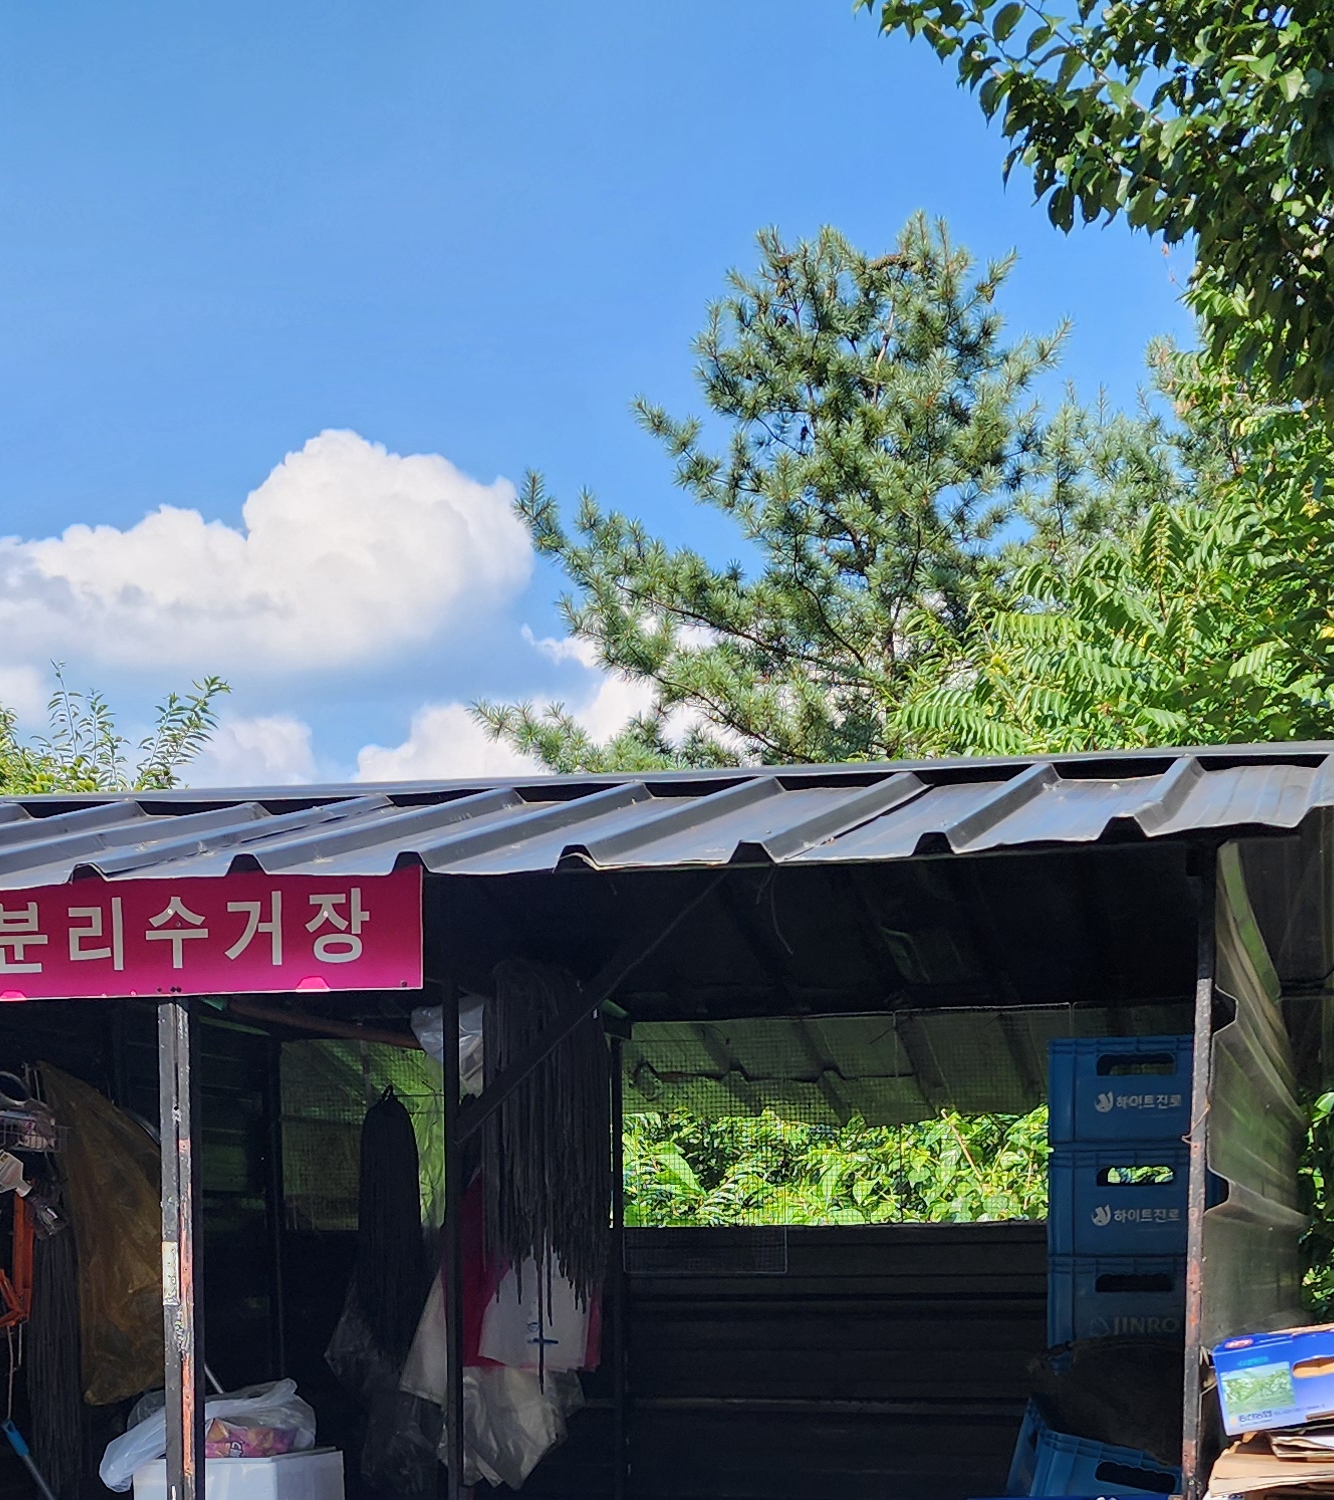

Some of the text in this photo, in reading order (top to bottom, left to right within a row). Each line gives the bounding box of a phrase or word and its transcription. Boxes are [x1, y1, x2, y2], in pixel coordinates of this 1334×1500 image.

[1116, 1093, 1182, 1109] 하이트진로
[1114, 1207, 1180, 1223] 하이트진로
[1114, 1315, 1179, 1335] JINRO
